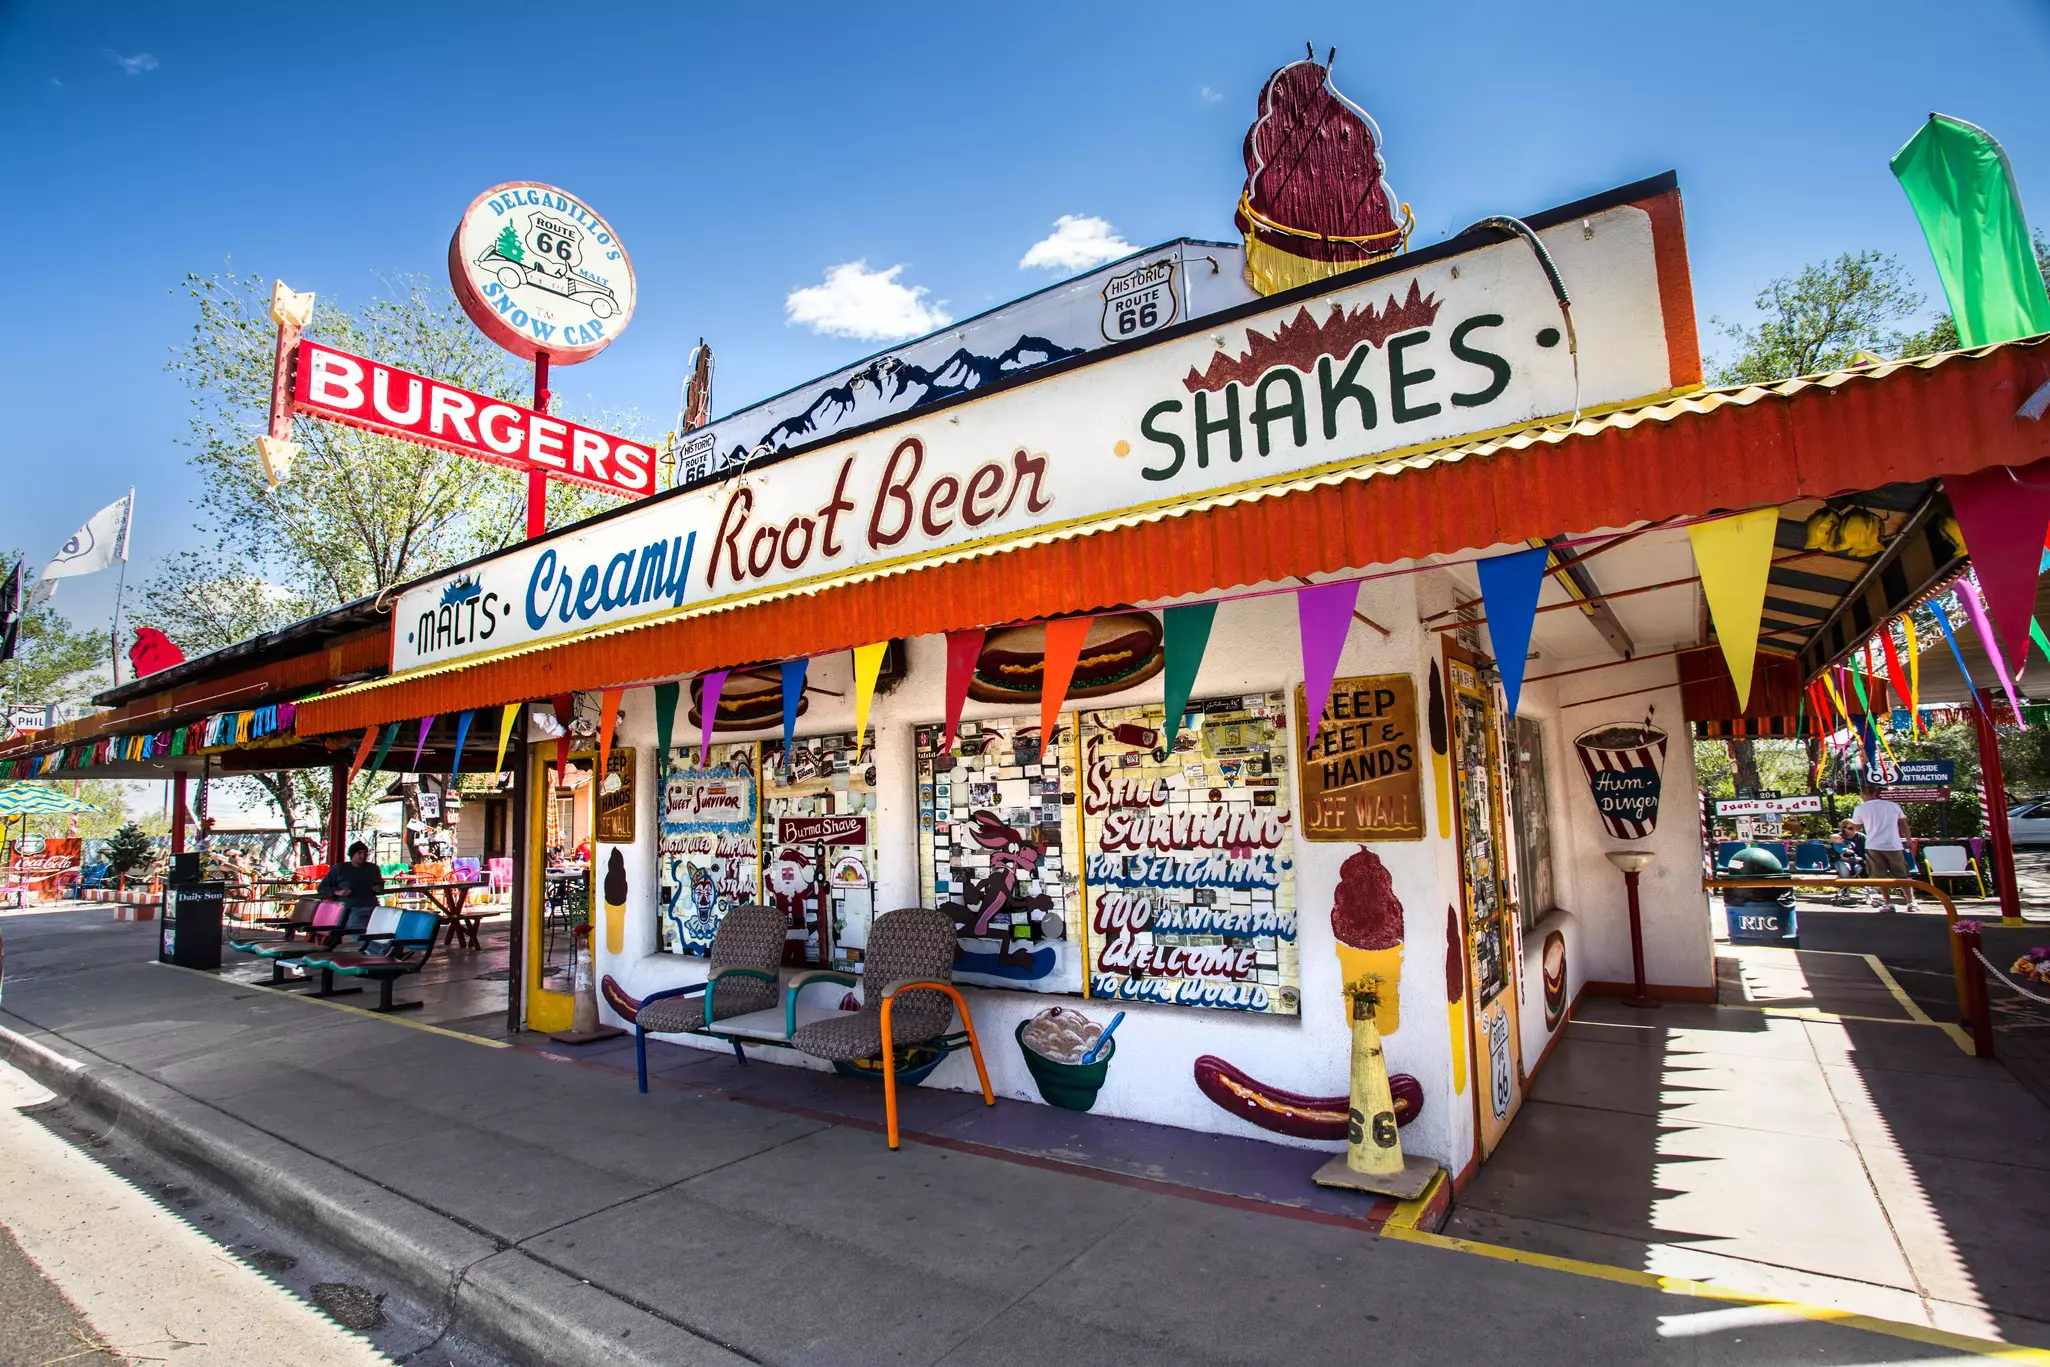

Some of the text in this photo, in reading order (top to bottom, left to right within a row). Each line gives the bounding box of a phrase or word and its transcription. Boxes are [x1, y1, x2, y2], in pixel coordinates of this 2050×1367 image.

[488, 189, 621, 262] DELGADILLO'S
[536, 217, 576, 239] ROUTE
[536, 232, 573, 262] 66
[579, 268, 610, 287] MALT
[1111, 265, 1166, 296] HISTORIC
[481, 281, 606, 346] SNOW CAP
[1115, 289, 1161, 313] ROUTE
[1119, 302, 1158, 335] 66
[1141, 313, 1512, 481] SHAKES
[308, 347, 650, 490] BURGERS
[684, 436, 712, 456] HISTORIC
[685, 453, 708, 469] ROUTE
[686, 463, 706, 484] 66
[706, 436, 1052, 588] Root Beer
[417, 530, 697, 656] MALTS Creamy
[18, 716, 44, 727] PHIL
[1382, 723, 1404, 742] &
[1323, 743, 1413, 790] HANDS
[1900, 764, 1939, 773] ROADSIDE
[1902, 773, 1948, 782] ATTRACTION
[694, 786, 741, 814] SURVIVOR
[1085, 757, 1167, 815] STILL
[1760, 791, 1777, 799] 204
[602, 789, 631, 813] HANDS
[1308, 795, 1417, 827] OFF WALL
[1600, 793, 1658, 820] Dinger
[1765, 799, 1818, 813] Garden
[783, 819, 857, 843] Burma Shave
[1100, 806, 1291, 852] SURVIVING
[1754, 824, 1780, 835] 4521
[1086, 852, 1128, 887] FOR
[179, 891, 223, 901] Daily Sun
[1094, 891, 1151, 934] 100
[1098, 931, 1258, 978] WELCOME
[1175, 979, 1269, 1010] WORLD
